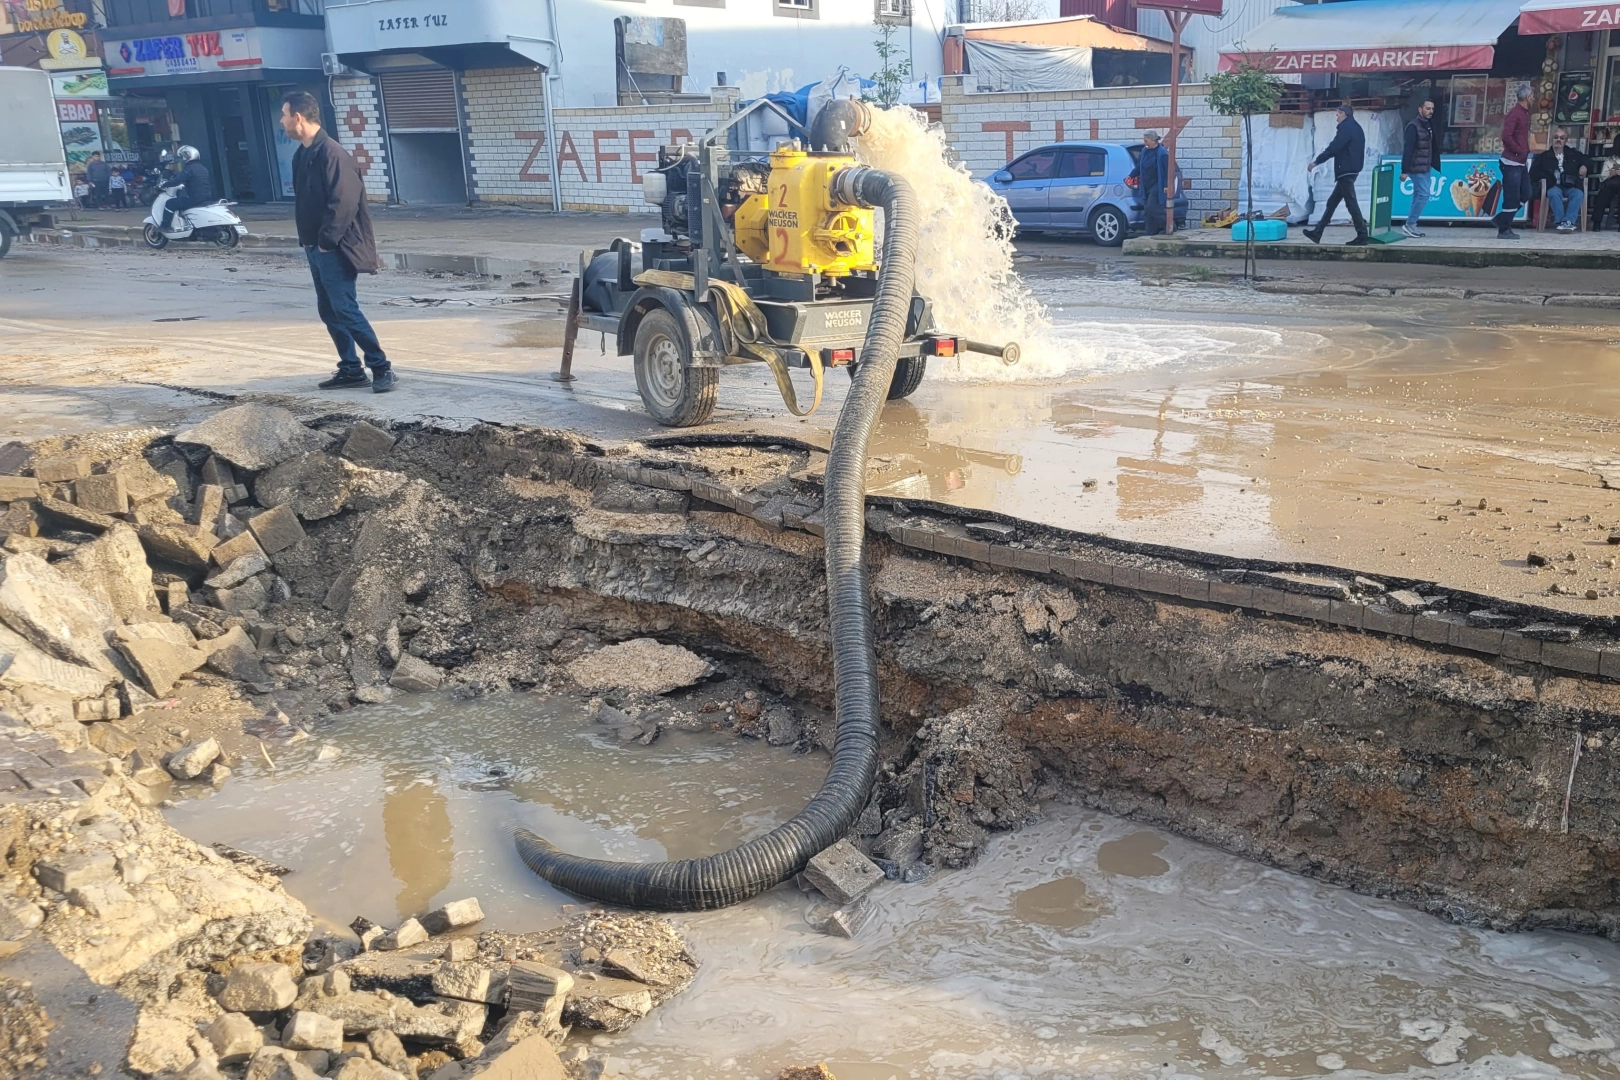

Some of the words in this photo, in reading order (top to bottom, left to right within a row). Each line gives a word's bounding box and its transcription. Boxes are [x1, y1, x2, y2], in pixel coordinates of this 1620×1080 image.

[377, 17, 419, 31] ZAFER
[423, 14, 448, 27] TUZ
[133, 37, 185, 61] ZAFER
[186, 32, 223, 57] TUZ
[1274, 54, 1337, 70] ZAFER
[1351, 50, 1438, 67] MARKET
[778, 184, 788, 207] 2
[768, 210, 798, 219] WACKER
[769, 218, 798, 228] NEUSON
[774, 228, 802, 268] 2
[825, 310, 862, 320] WACKER
[825, 317, 862, 328] NEUSON
